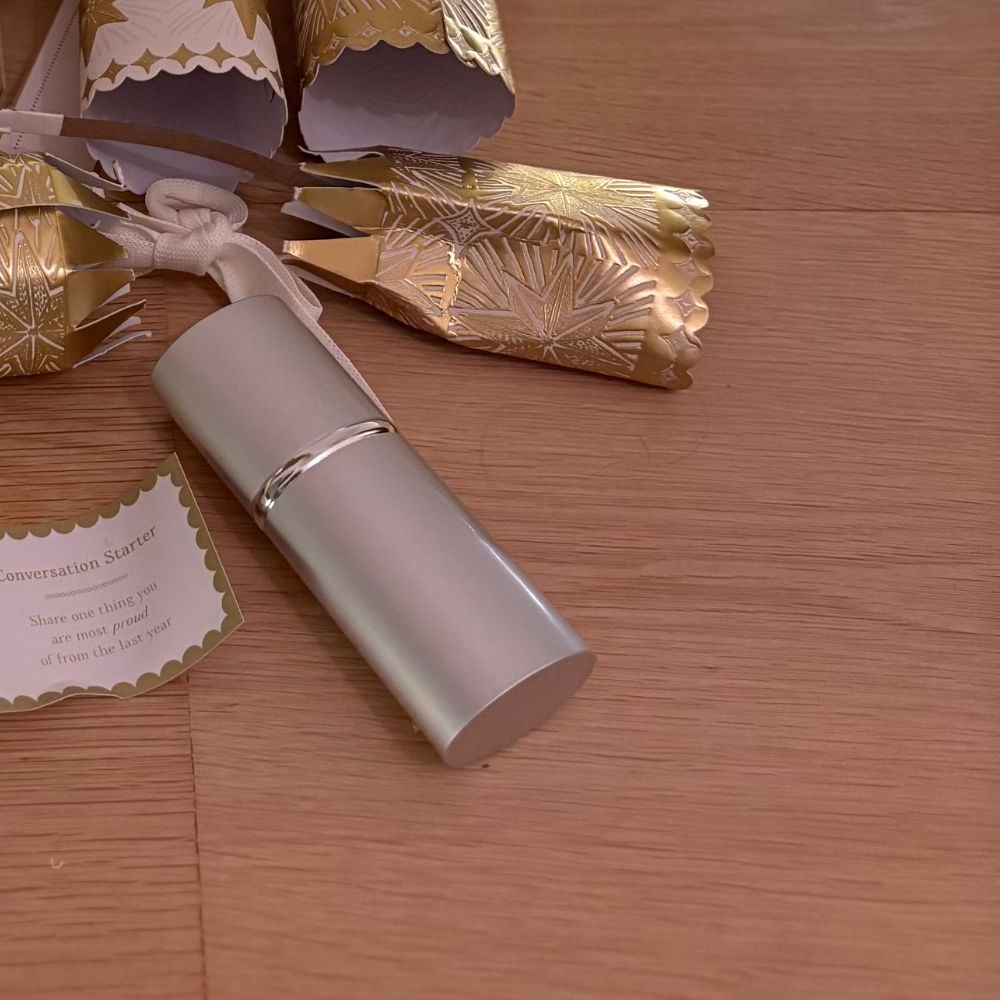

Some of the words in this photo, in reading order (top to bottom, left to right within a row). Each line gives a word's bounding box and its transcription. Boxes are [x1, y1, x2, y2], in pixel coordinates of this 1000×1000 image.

[104, 524, 157, 564] Starter
[29, 614, 67, 627] Share
[71, 609, 95, 623] one
[98, 595, 134, 616] thing
[136, 583, 157, 602] you
[51, 634, 72, 645] are
[76, 625, 108, 641] most
[112, 606, 149, 635] proud
[41, 655, 53, 666] of
[56, 651, 89, 665] from
[93, 643, 115, 659] the
[119, 633, 143, 650] last
[146, 617, 172, 642] year
